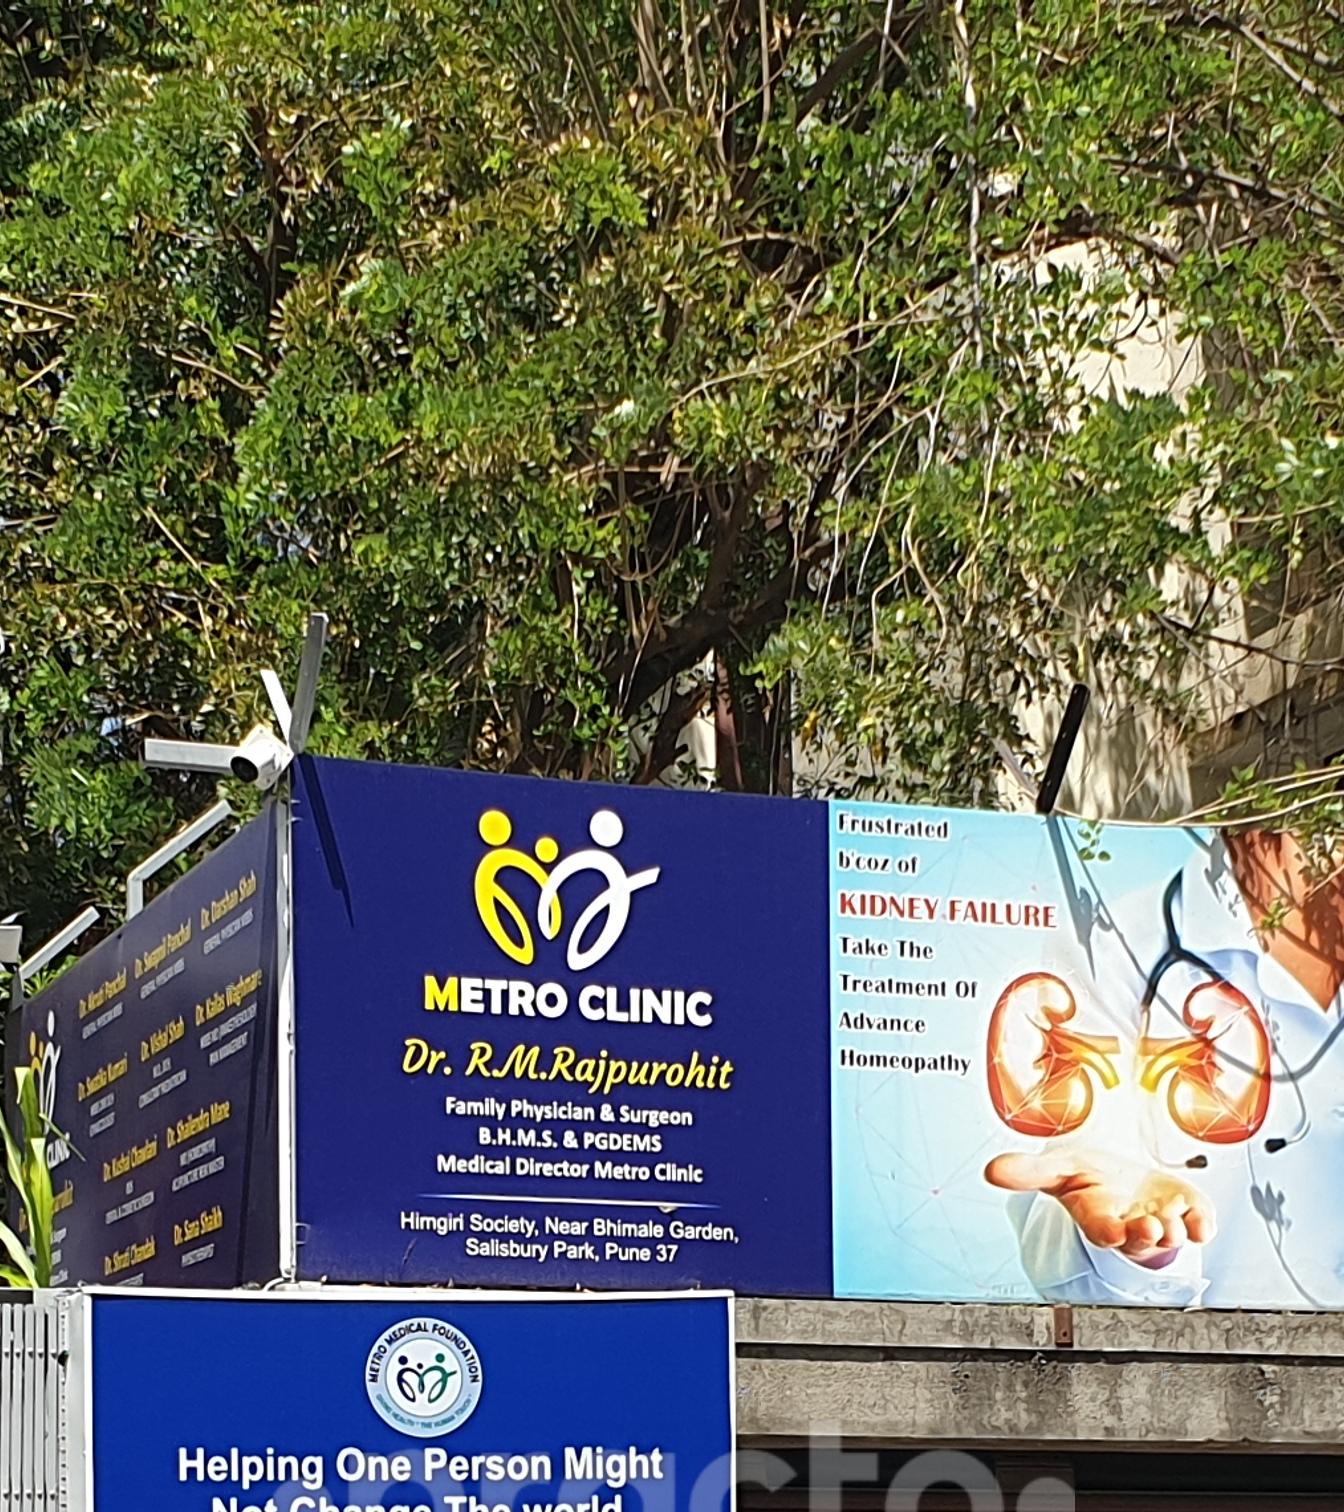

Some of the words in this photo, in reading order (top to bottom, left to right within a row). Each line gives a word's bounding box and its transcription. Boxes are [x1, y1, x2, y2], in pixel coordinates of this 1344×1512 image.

[838, 813, 949, 840] Frustrated
[839, 851, 888, 870] b'coz
[898, 857, 916, 873] of
[841, 893, 937, 919] KIDNEY
[950, 900, 1056, 927] FAILURE
[842, 937, 887, 955] Take
[899, 941, 932, 958] The
[842, 975, 945, 996] Treatment
[956, 981, 976, 997] Of
[425, 976, 567, 1017] METRO
[579, 985, 712, 1026] CLINIC
[840, 1012, 924, 1032] Advance
[403, 1038, 451, 1075] Dr.
[465, 1042, 733, 1094] R.M.Rajpurohit
[841, 1049, 968, 1075] Homeopathy
[179, 1448, 323, 1490] Helping
[337, 1447, 411, 1481] One
[425, 1448, 551, 1481] Person
[565, 1447, 663, 1488] Might
